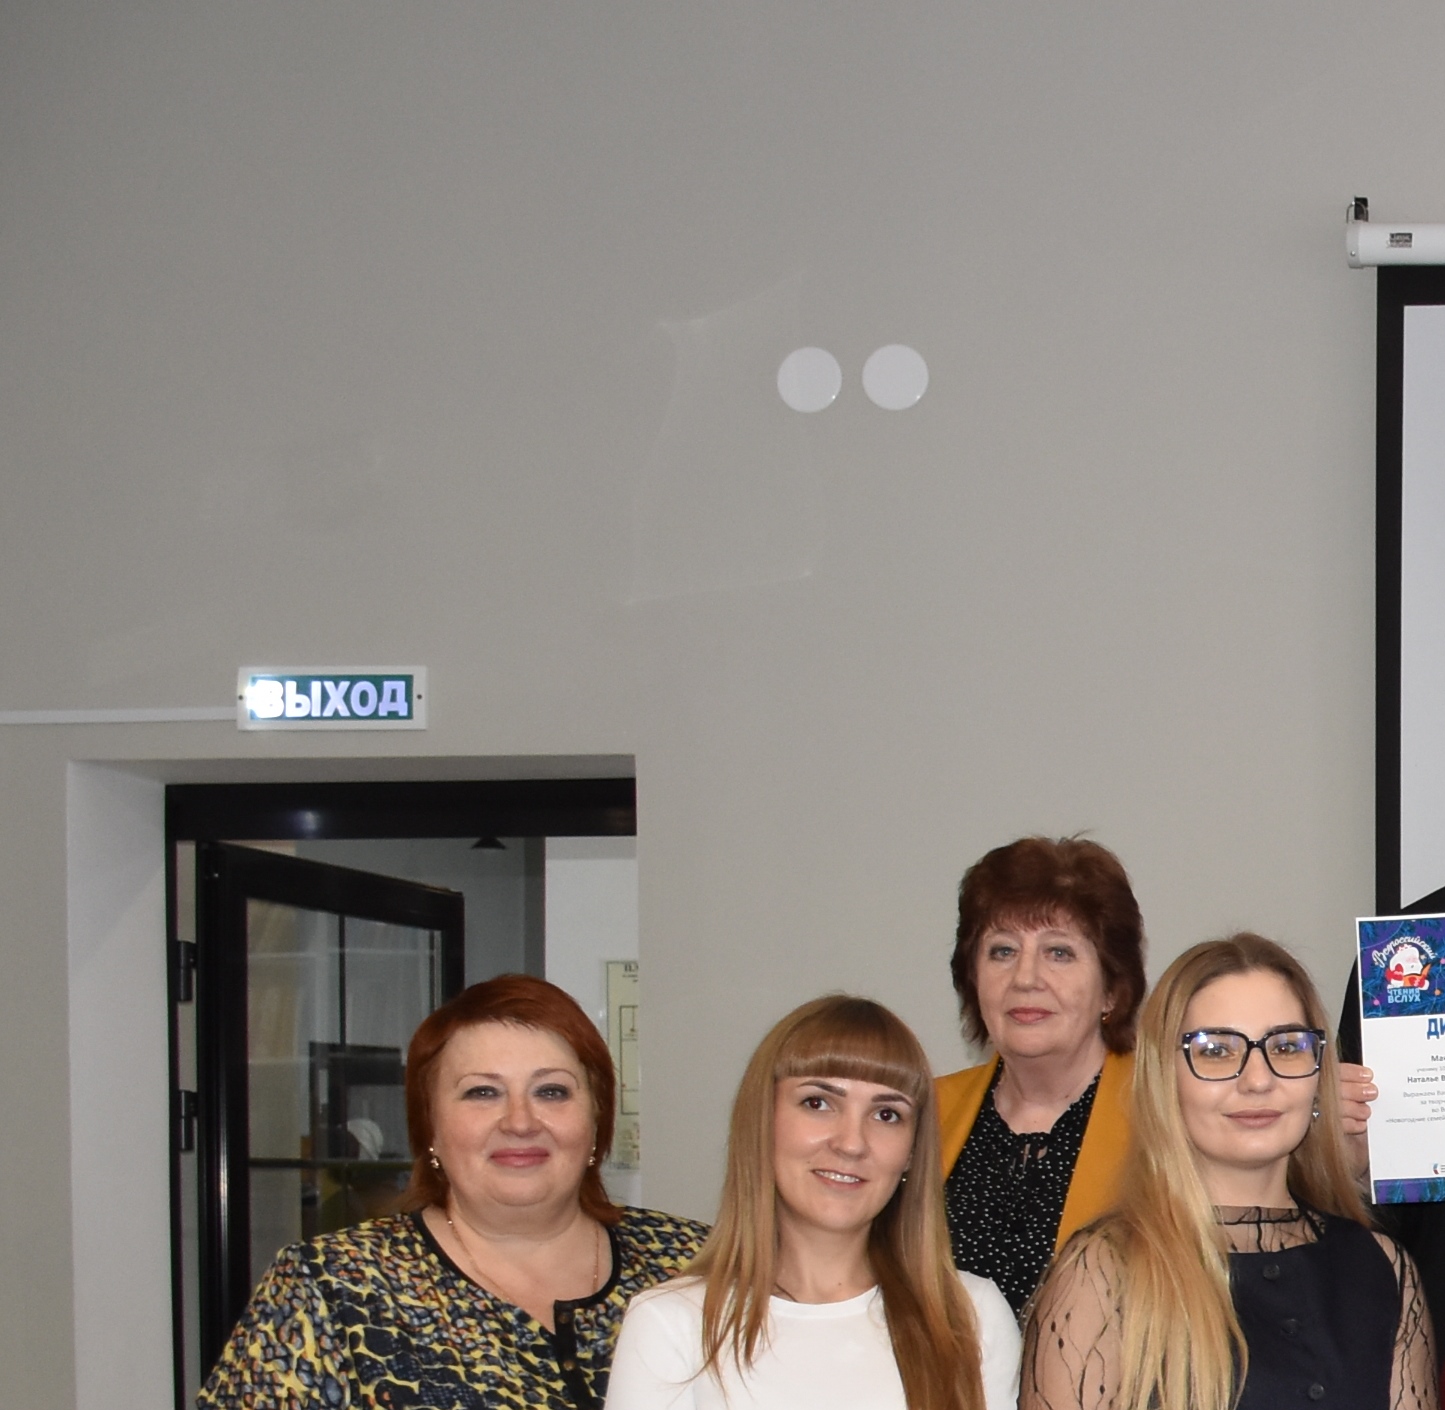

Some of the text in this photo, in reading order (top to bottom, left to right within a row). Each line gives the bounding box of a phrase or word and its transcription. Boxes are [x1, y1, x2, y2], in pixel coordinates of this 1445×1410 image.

[249, 679, 408, 718] ВЫХОД
[1387, 986, 1420, 995] ЧТЕНИЯ
[1388, 993, 1421, 1003] ВСЛУХ
